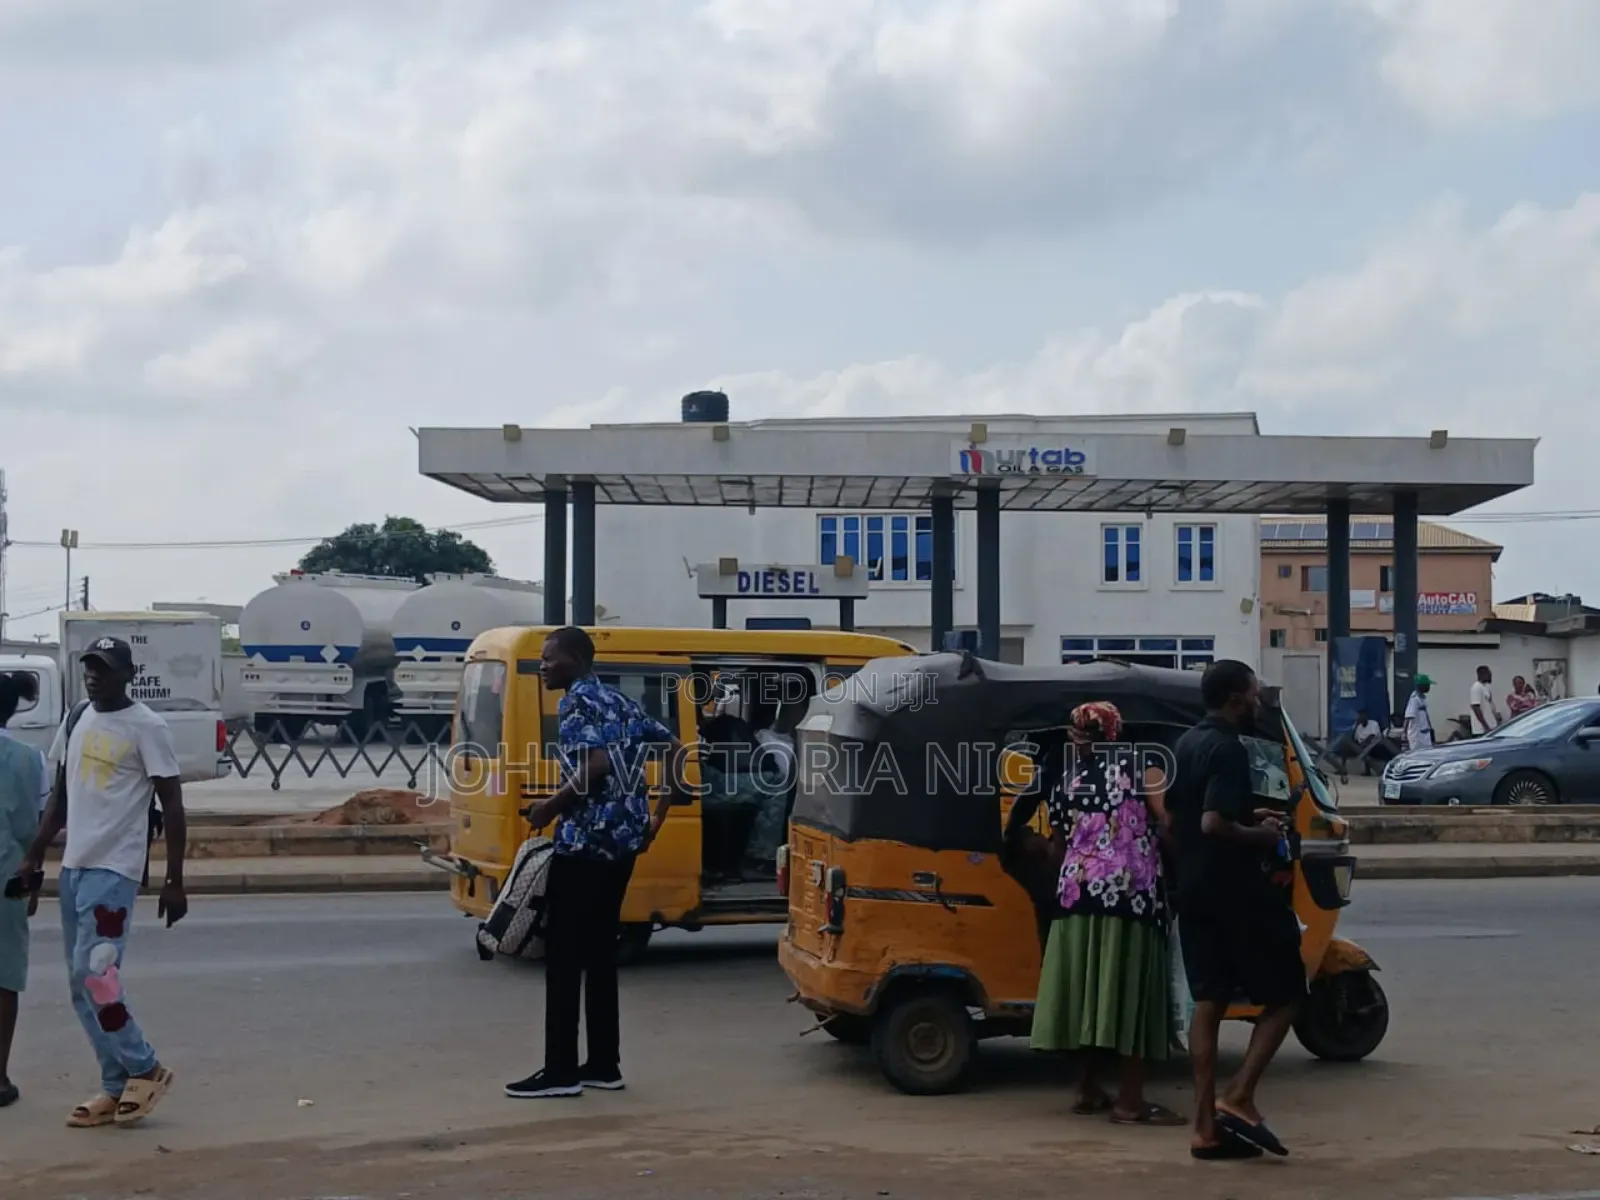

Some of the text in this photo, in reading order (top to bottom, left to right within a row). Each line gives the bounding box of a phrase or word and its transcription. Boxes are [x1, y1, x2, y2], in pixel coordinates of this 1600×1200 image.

[998, 465, 1025, 473] OIL
[1047, 465, 1084, 473] GAS
[738, 571, 819, 593] DIESEL
[1418, 593, 1476, 605] AutoCAD
[131, 635, 148, 644] THE
[131, 676, 160, 687] CAFE
[131, 688, 171, 698] RHUM!
